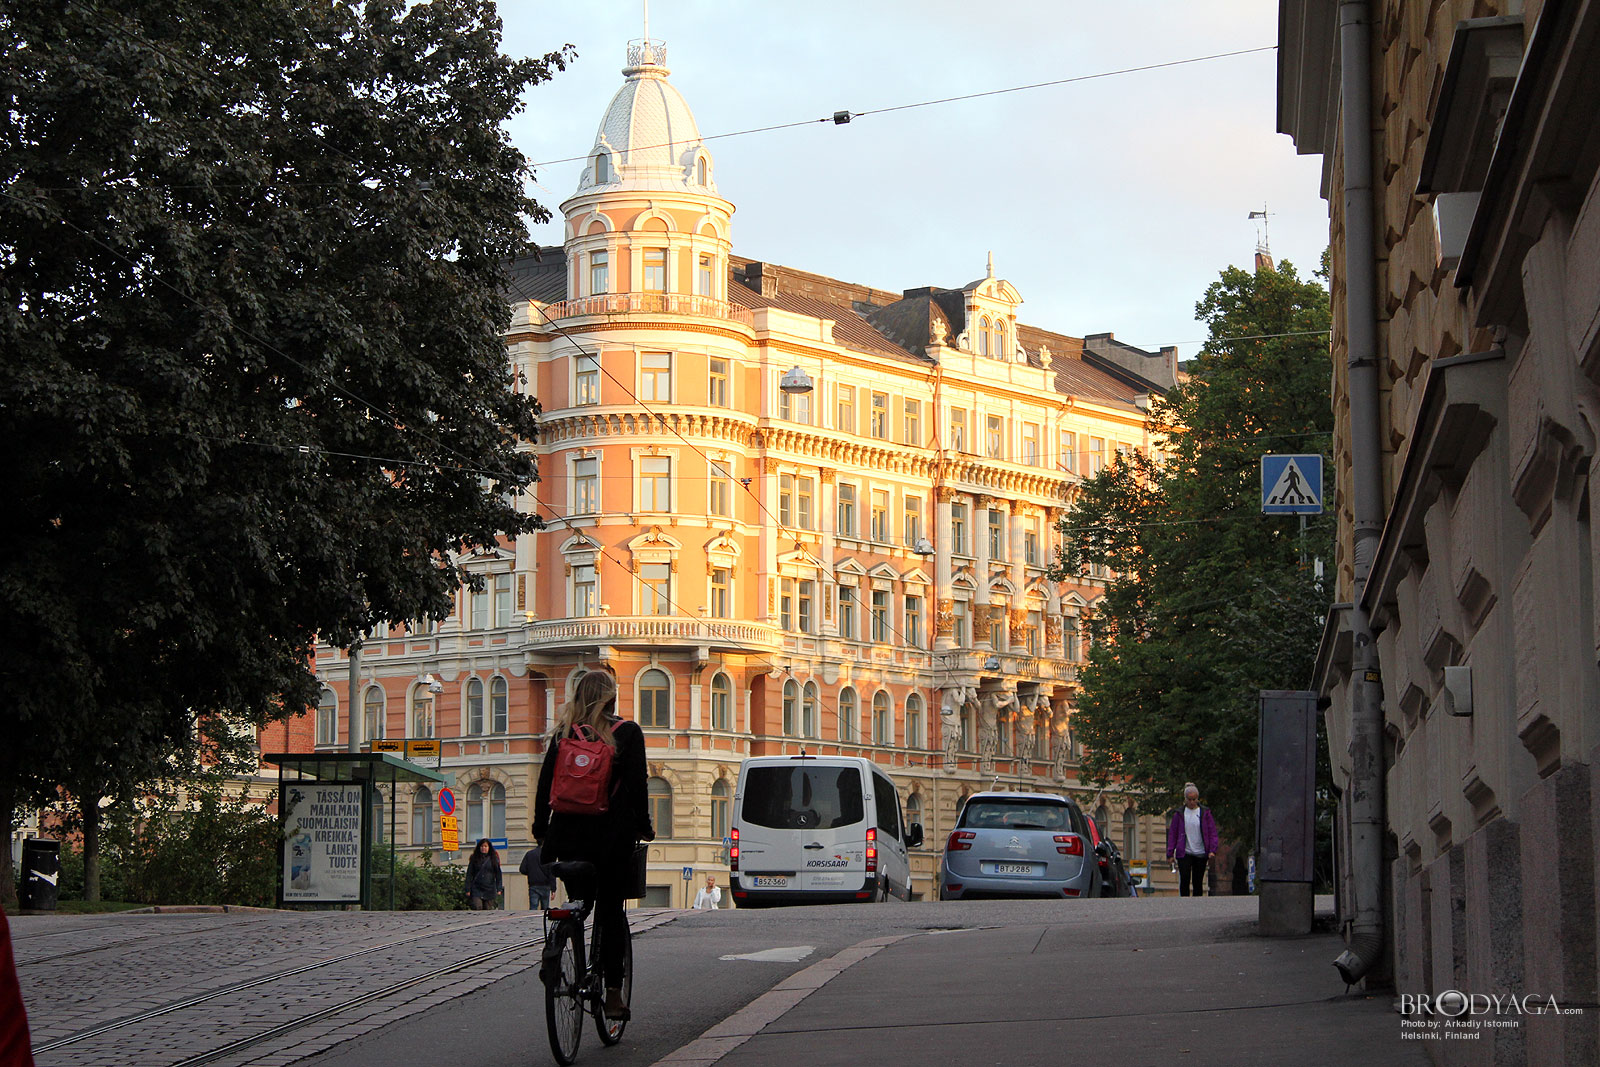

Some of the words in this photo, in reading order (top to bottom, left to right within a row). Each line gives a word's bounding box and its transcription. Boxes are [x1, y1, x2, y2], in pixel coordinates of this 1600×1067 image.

[347, 791, 360, 803] ON
[310, 804, 359, 816] MAAILMAN
[297, 817, 359, 830] SUOMALAISIN
[315, 830, 358, 842] KREIKKA-
[326, 844, 358, 855] LAINEN
[329, 857, 357, 868] TUOTE
[806, 860, 849, 868] KORSISAARI
[1000, 865, 1031, 873] BTJ-285
[758, 878, 786, 886] BSZ-360
